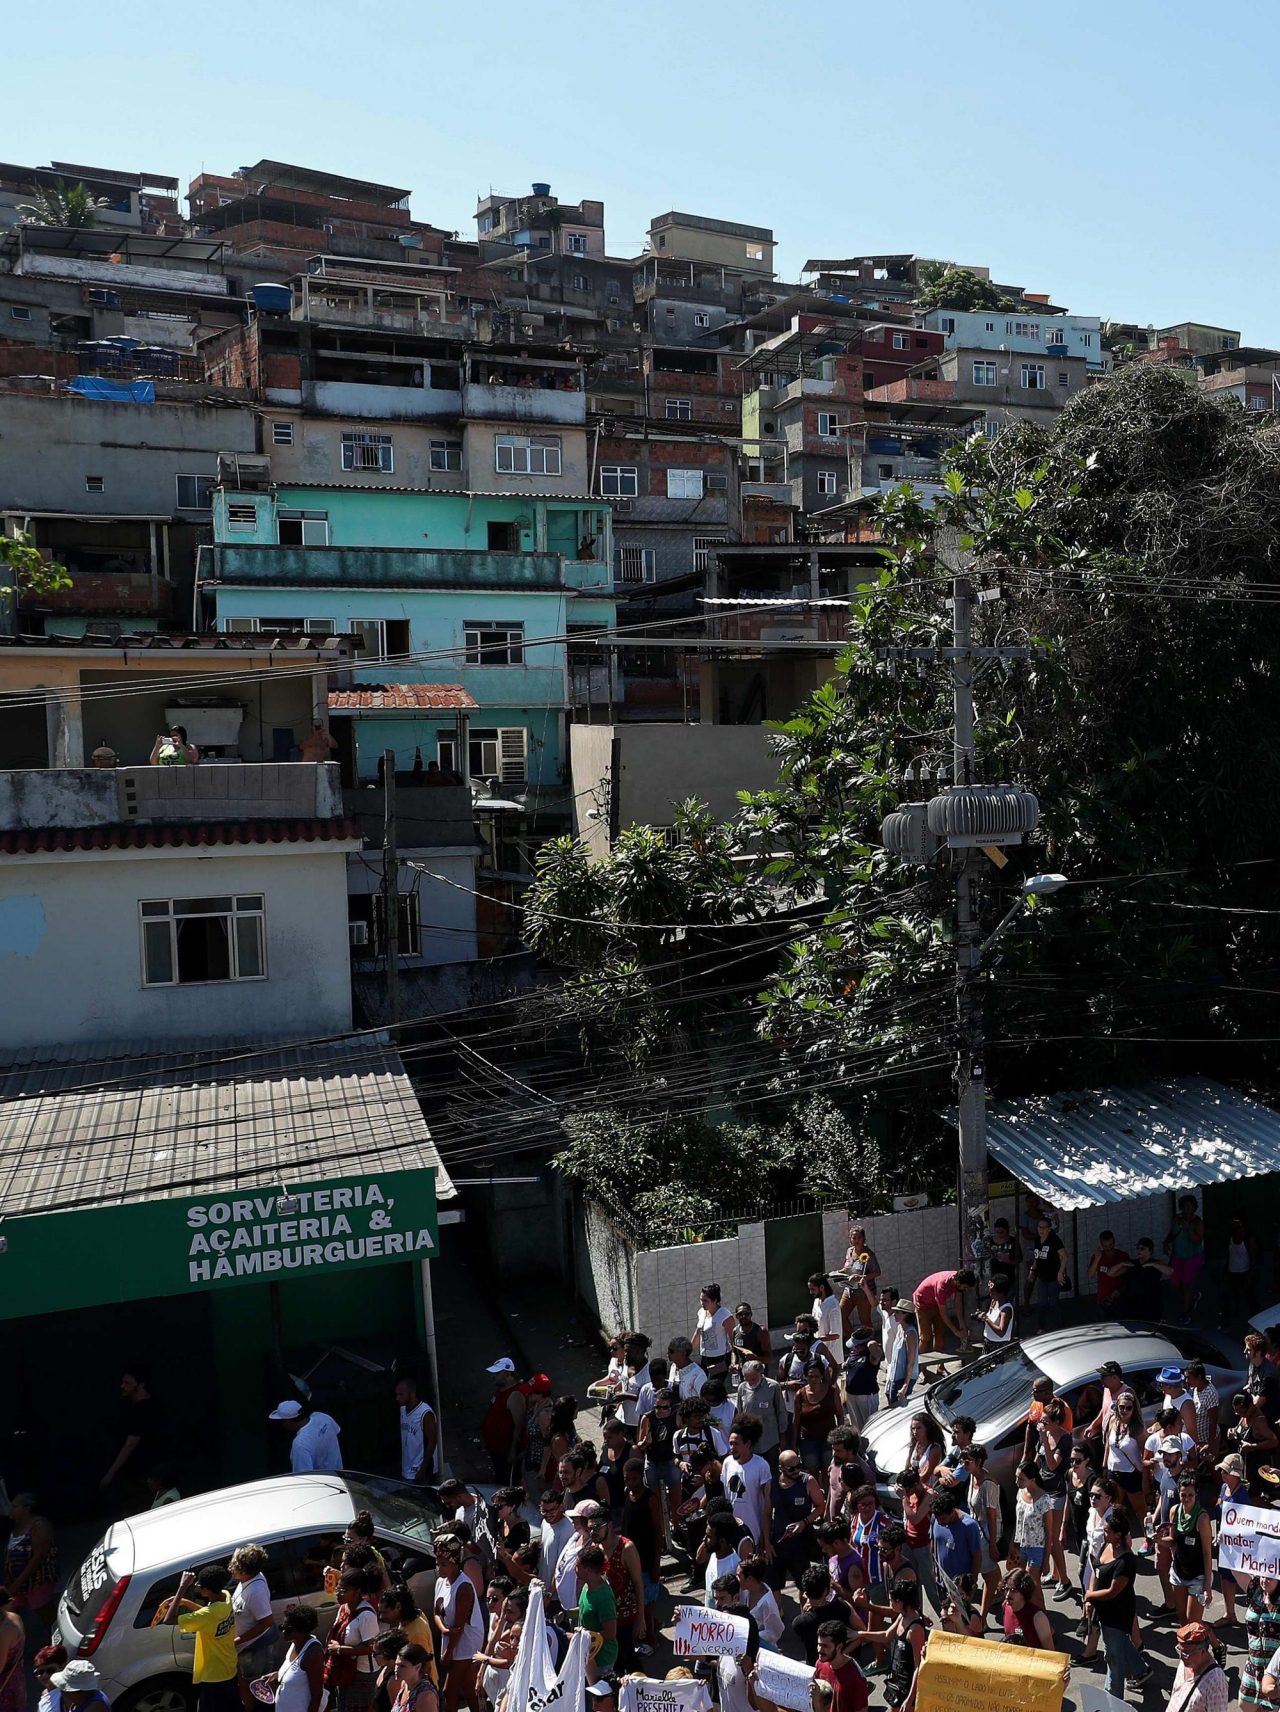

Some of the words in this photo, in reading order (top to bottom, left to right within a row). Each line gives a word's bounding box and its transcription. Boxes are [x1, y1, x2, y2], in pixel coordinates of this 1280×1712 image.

[187, 1184, 395, 1228] SORVTERIA,
[189, 1214, 352, 1256] AÇAITERIA
[369, 1209, 393, 1230] &
[189, 1228, 435, 1283] HAMBURGUERIA
[1226, 1508, 1254, 1527] Quem
[1224, 1533, 1254, 1549] matar
[91, 1543, 108, 1590] JESUS
[681, 1608, 693, 1619] NA
[690, 1622, 735, 1644] MORRO
[636, 1688, 676, 1702] Marielle
[637, 1702, 684, 1712] PRESENTE!
